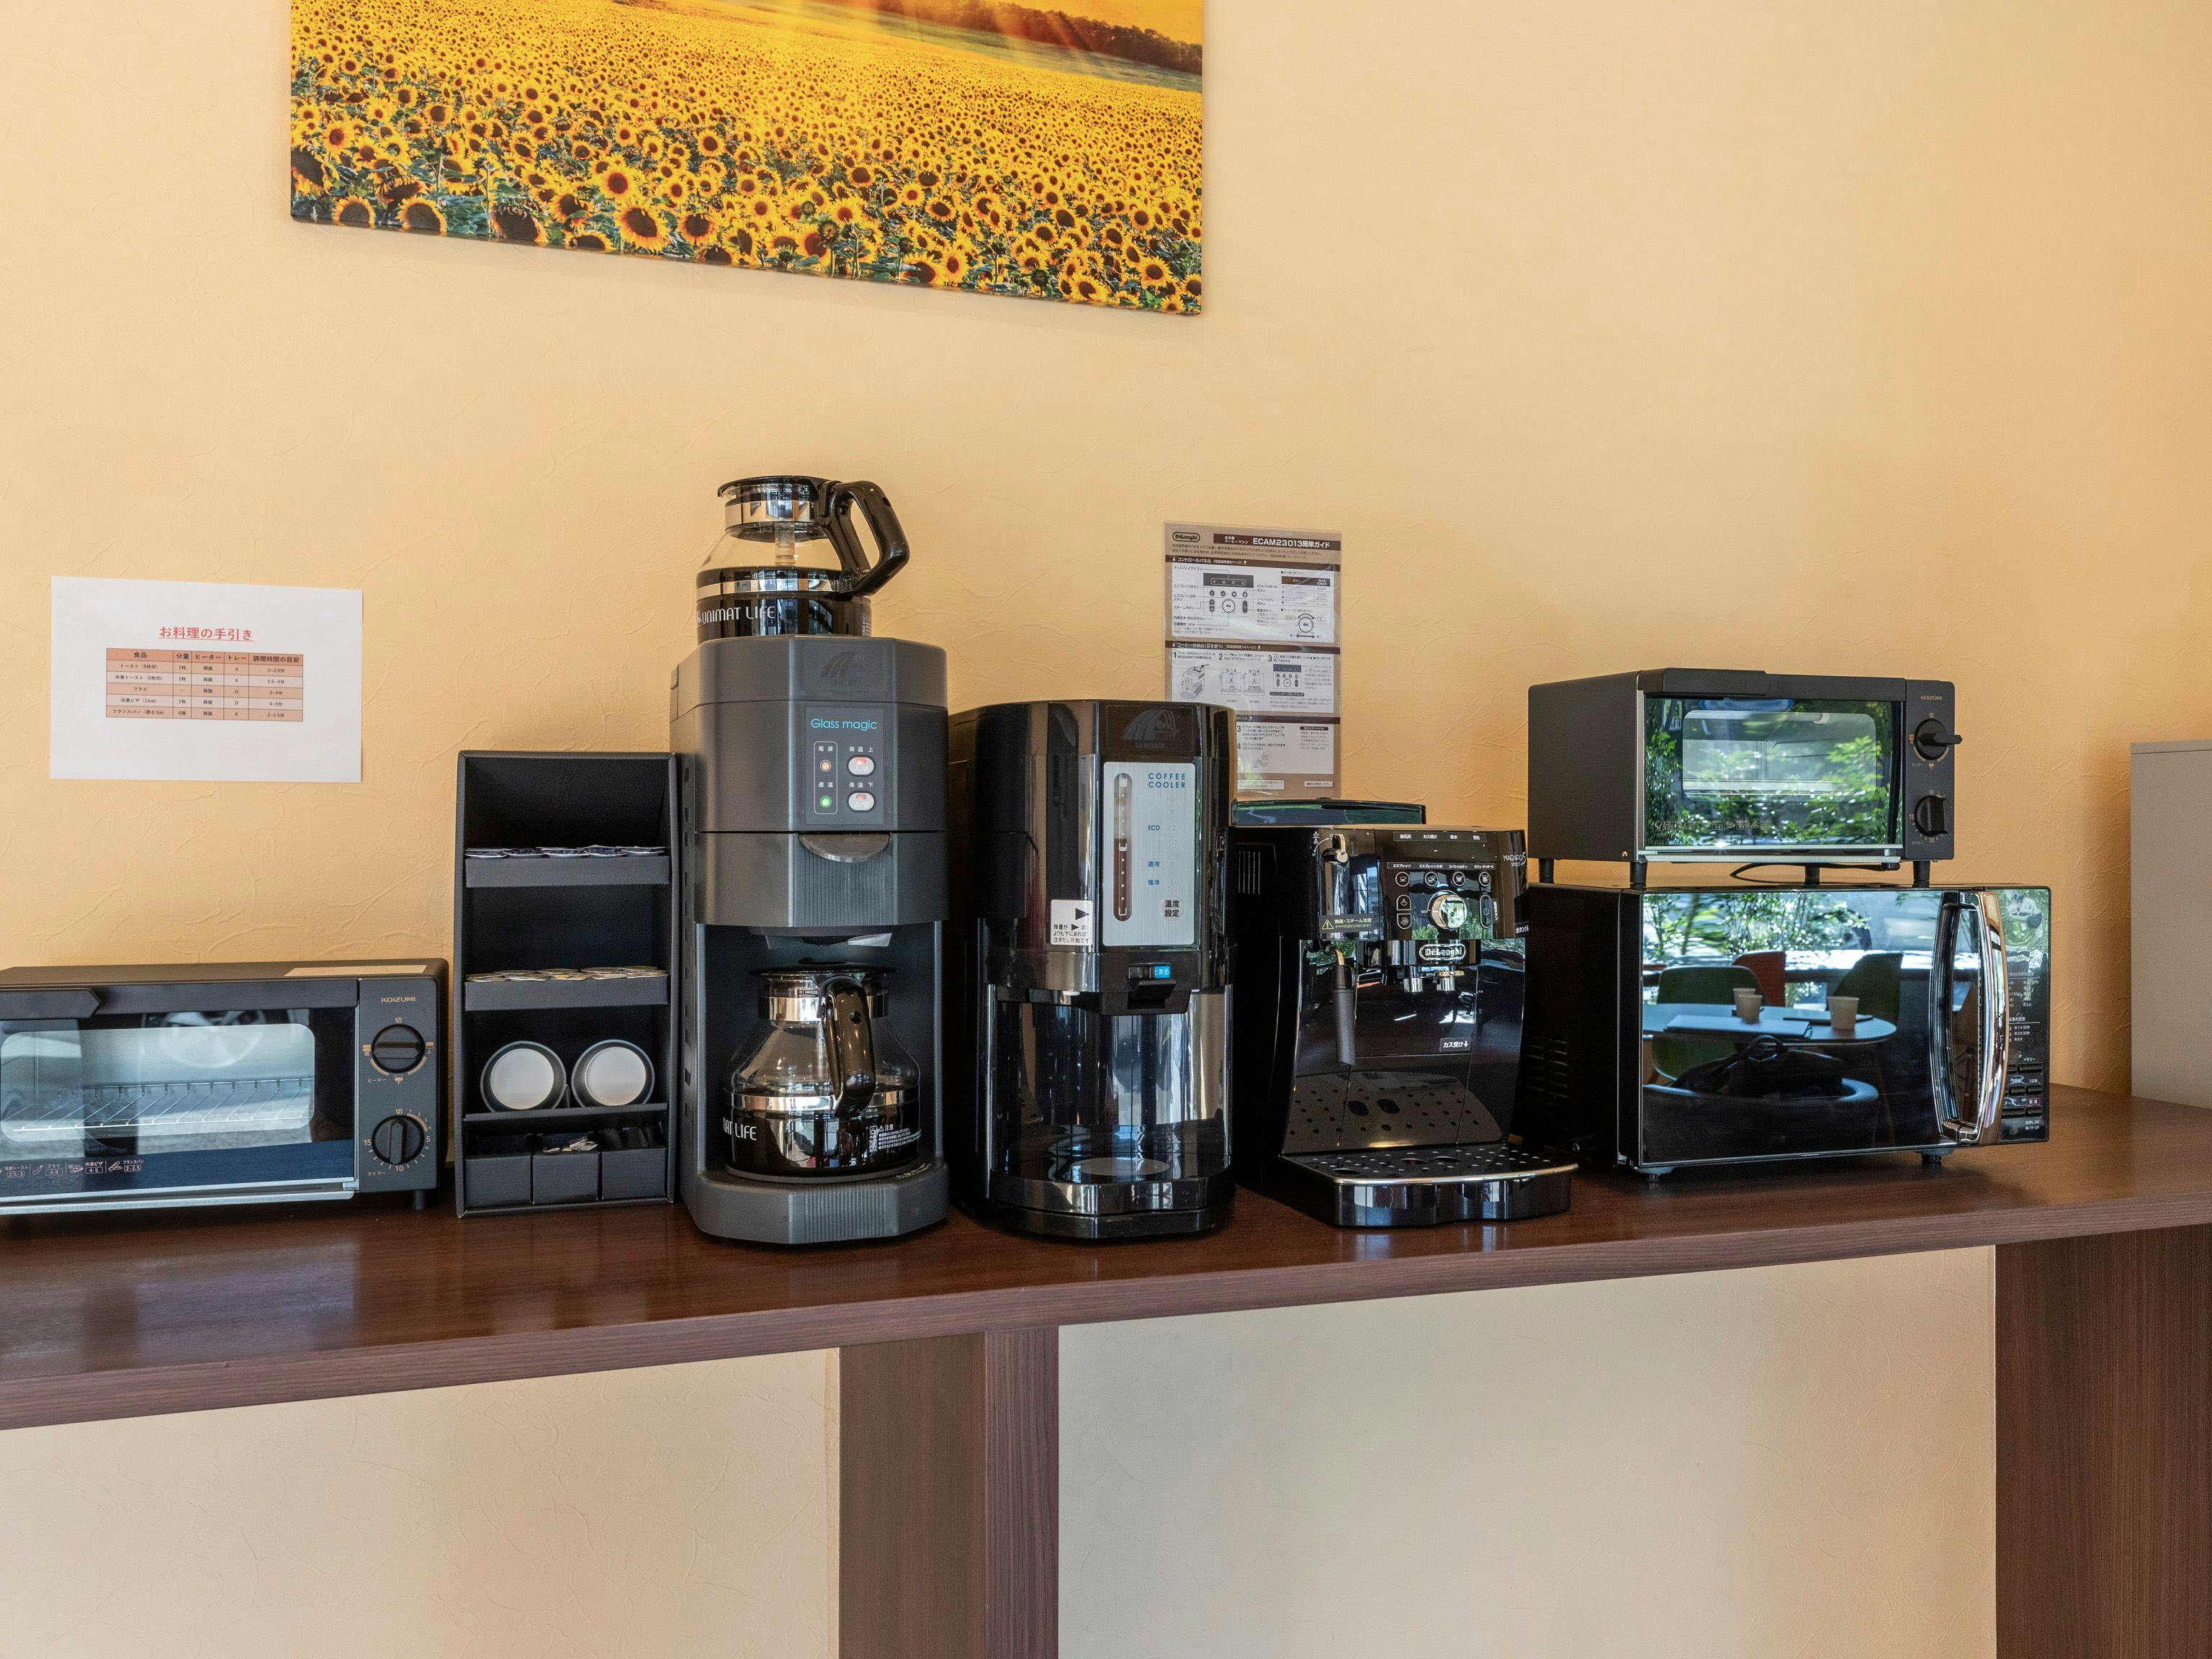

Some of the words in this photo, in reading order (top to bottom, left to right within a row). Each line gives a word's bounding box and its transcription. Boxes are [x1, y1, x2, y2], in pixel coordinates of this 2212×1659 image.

[702, 607, 742, 624] UNIMAT
[745, 606, 775, 619] LIFE
[160, 626, 252, 641] お料理の手引き
[811, 718, 840, 729] Glass
[842, 719, 878, 732] magic
[1164, 909, 1179, 917] 設定
[734, 1123, 757, 1141] LIFE
